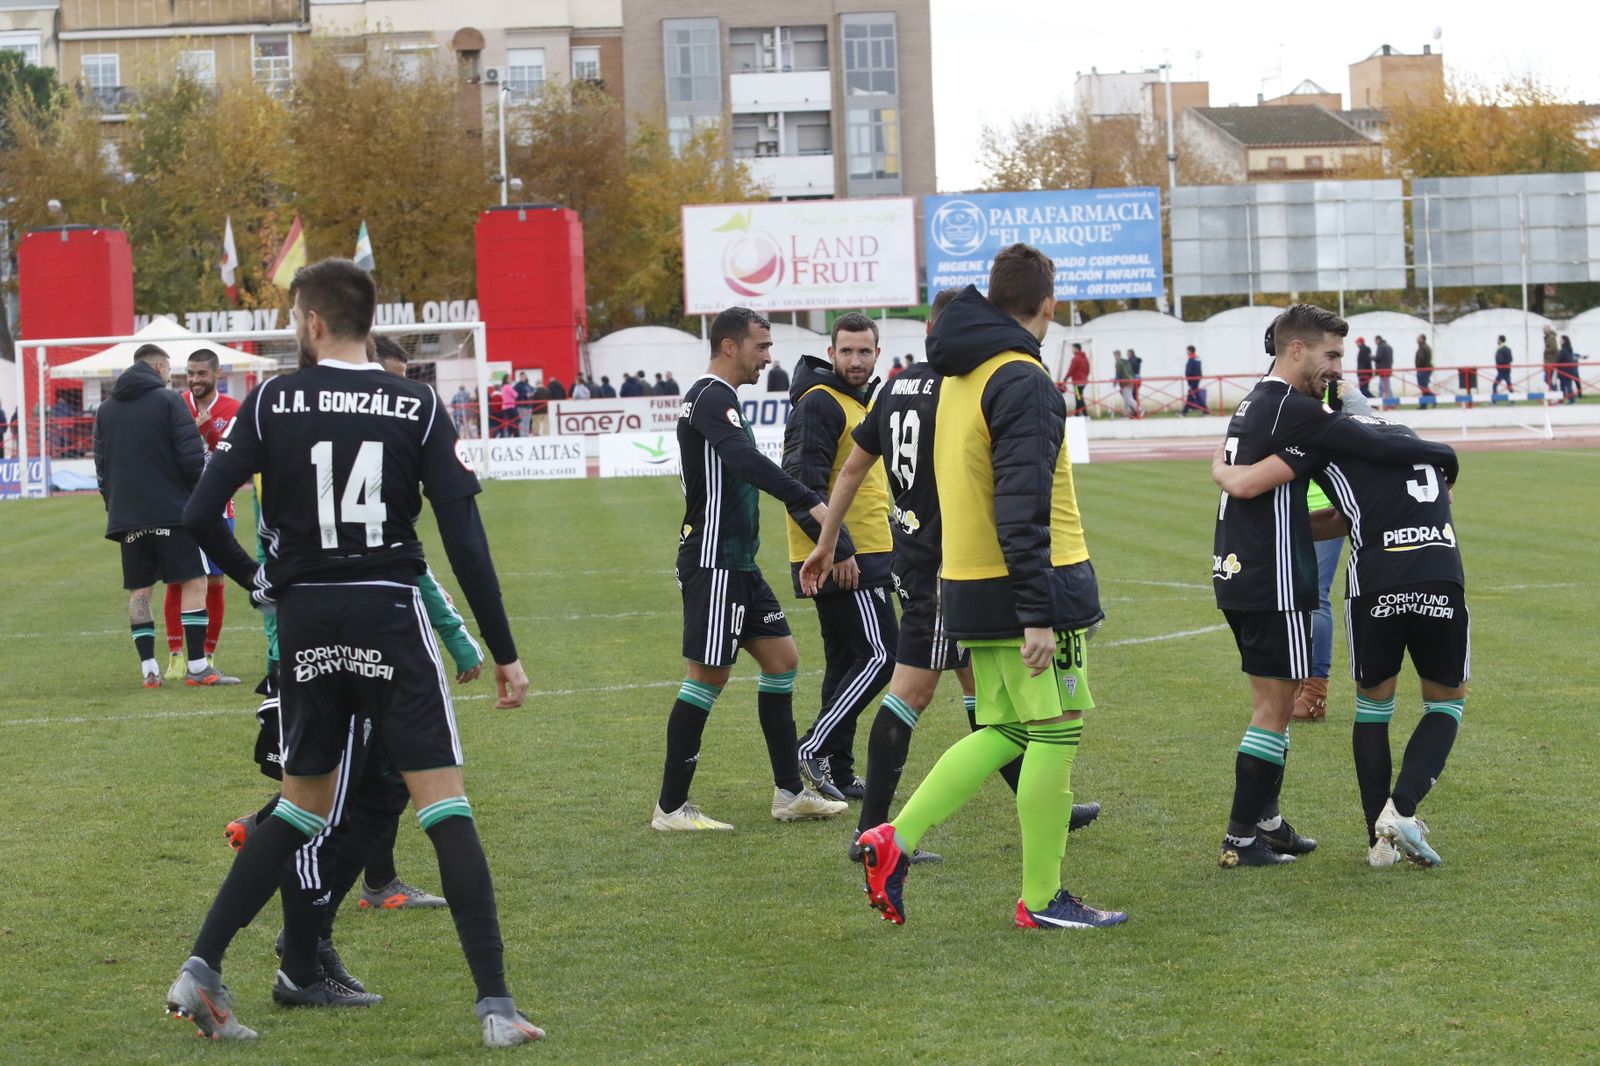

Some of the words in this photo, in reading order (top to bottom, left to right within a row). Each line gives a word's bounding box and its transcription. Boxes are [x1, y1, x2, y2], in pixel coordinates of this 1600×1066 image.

[990, 202, 1154, 226] PARAFARMACIA
[790, 234, 879, 260] LAND
[937, 260, 984, 273] HIGIENE
[1089, 253, 1151, 267] CORPORAL
[791, 261, 879, 285] FRUIT
[932, 274, 990, 288] PRODUCT
[1105, 267, 1157, 281] INFANTIL
[1087, 282, 1153, 295] ORTOPEDIA
[319, 389, 421, 421] GONZÁLEZ
[529, 443, 581, 461] ALTAS
[889, 409, 921, 490] 19
[311, 441, 387, 549] 14
[1378, 592, 1449, 608] CORHYUND
[1396, 600, 1454, 620] HYUNDAI
[730, 602, 746, 636] 10
[295, 644, 382, 665] CORHYUND
[319, 658, 395, 681] HYUNDAI
